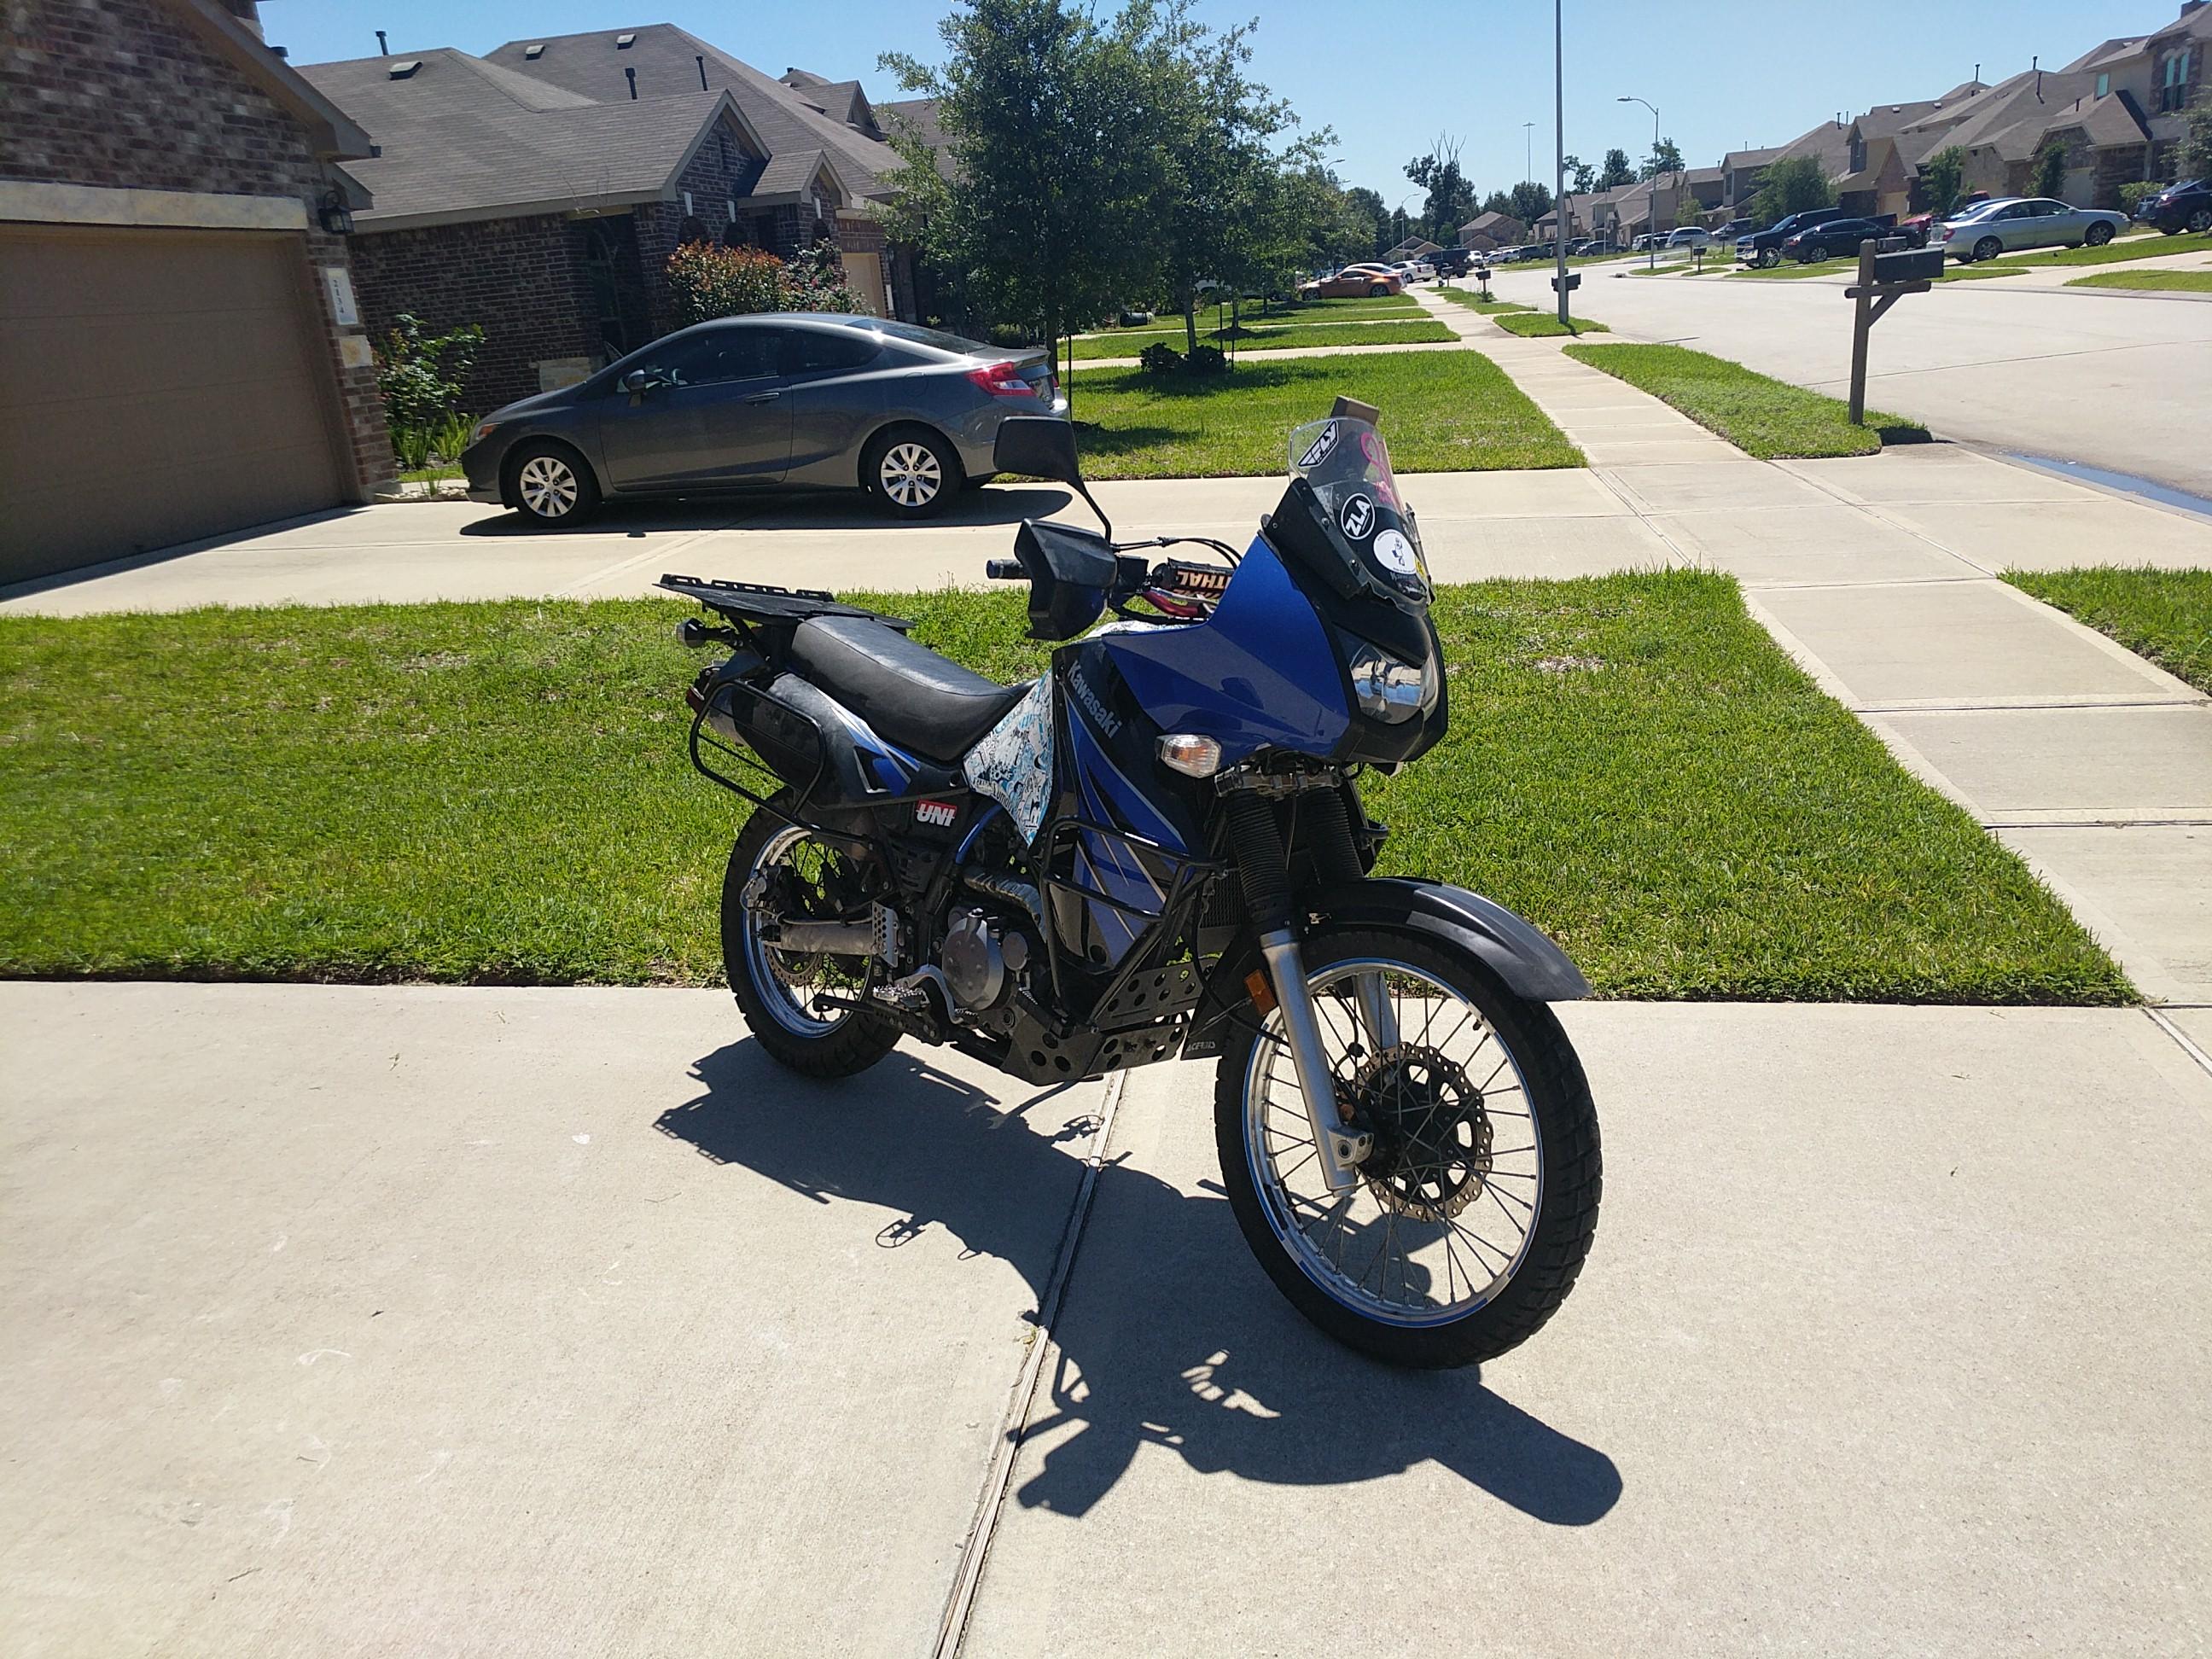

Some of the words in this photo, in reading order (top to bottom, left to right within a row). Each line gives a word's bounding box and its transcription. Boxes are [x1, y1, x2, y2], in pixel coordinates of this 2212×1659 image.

[1300, 422, 1336, 464] FLY
[1345, 499, 1371, 537] ZLA
[1067, 660, 1122, 739] Kawasaki
[916, 803, 956, 827] UNI
